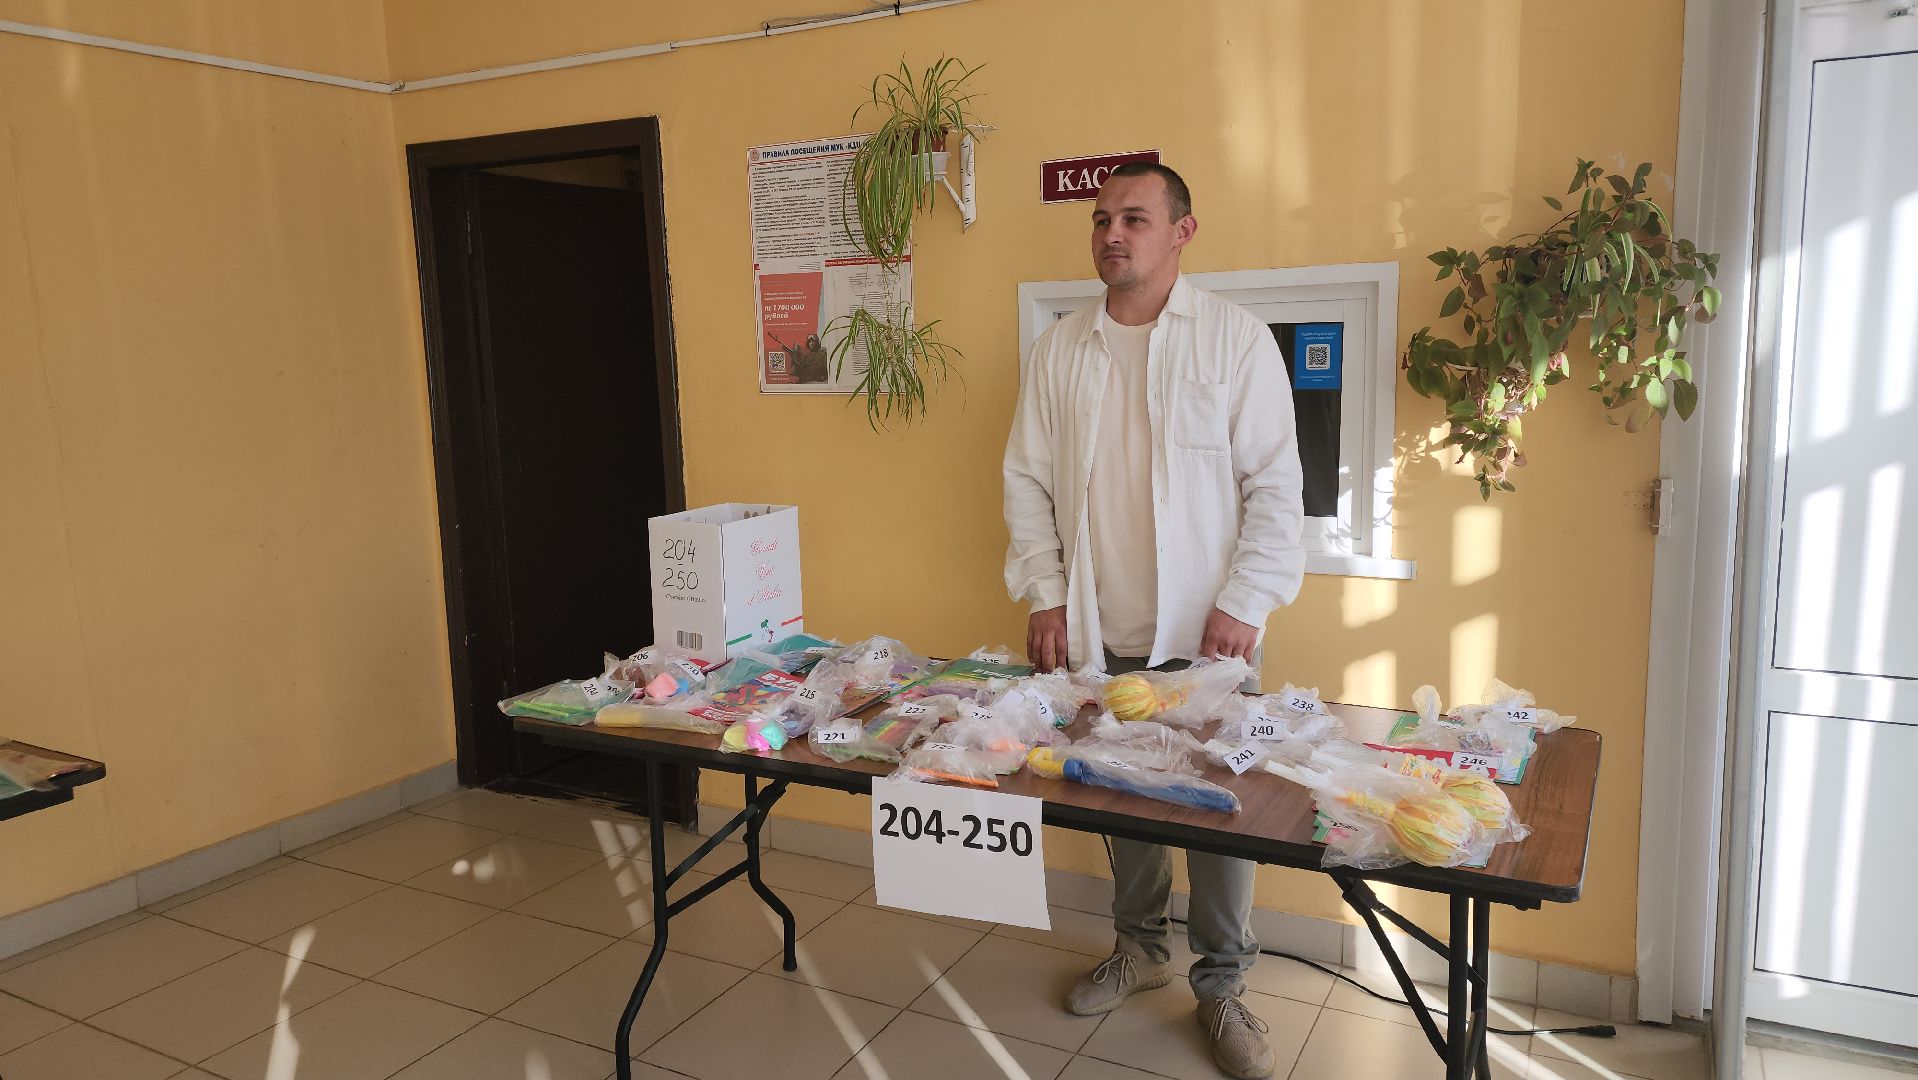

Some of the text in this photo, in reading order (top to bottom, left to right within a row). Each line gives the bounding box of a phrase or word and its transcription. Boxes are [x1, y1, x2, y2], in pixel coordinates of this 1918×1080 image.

[1056, 164, 1121, 192] КАС
[663, 538, 696, 563] 204
[662, 567, 699, 591] 250
[799, 687, 817, 700] 215
[1292, 697, 1315, 711] 238
[823, 732, 846, 741] 221
[1250, 725, 1274, 737] 240
[1231, 749, 1256, 766] 241
[1460, 756, 1487, 766] 246
[879, 803, 1033, 857] 204-250
